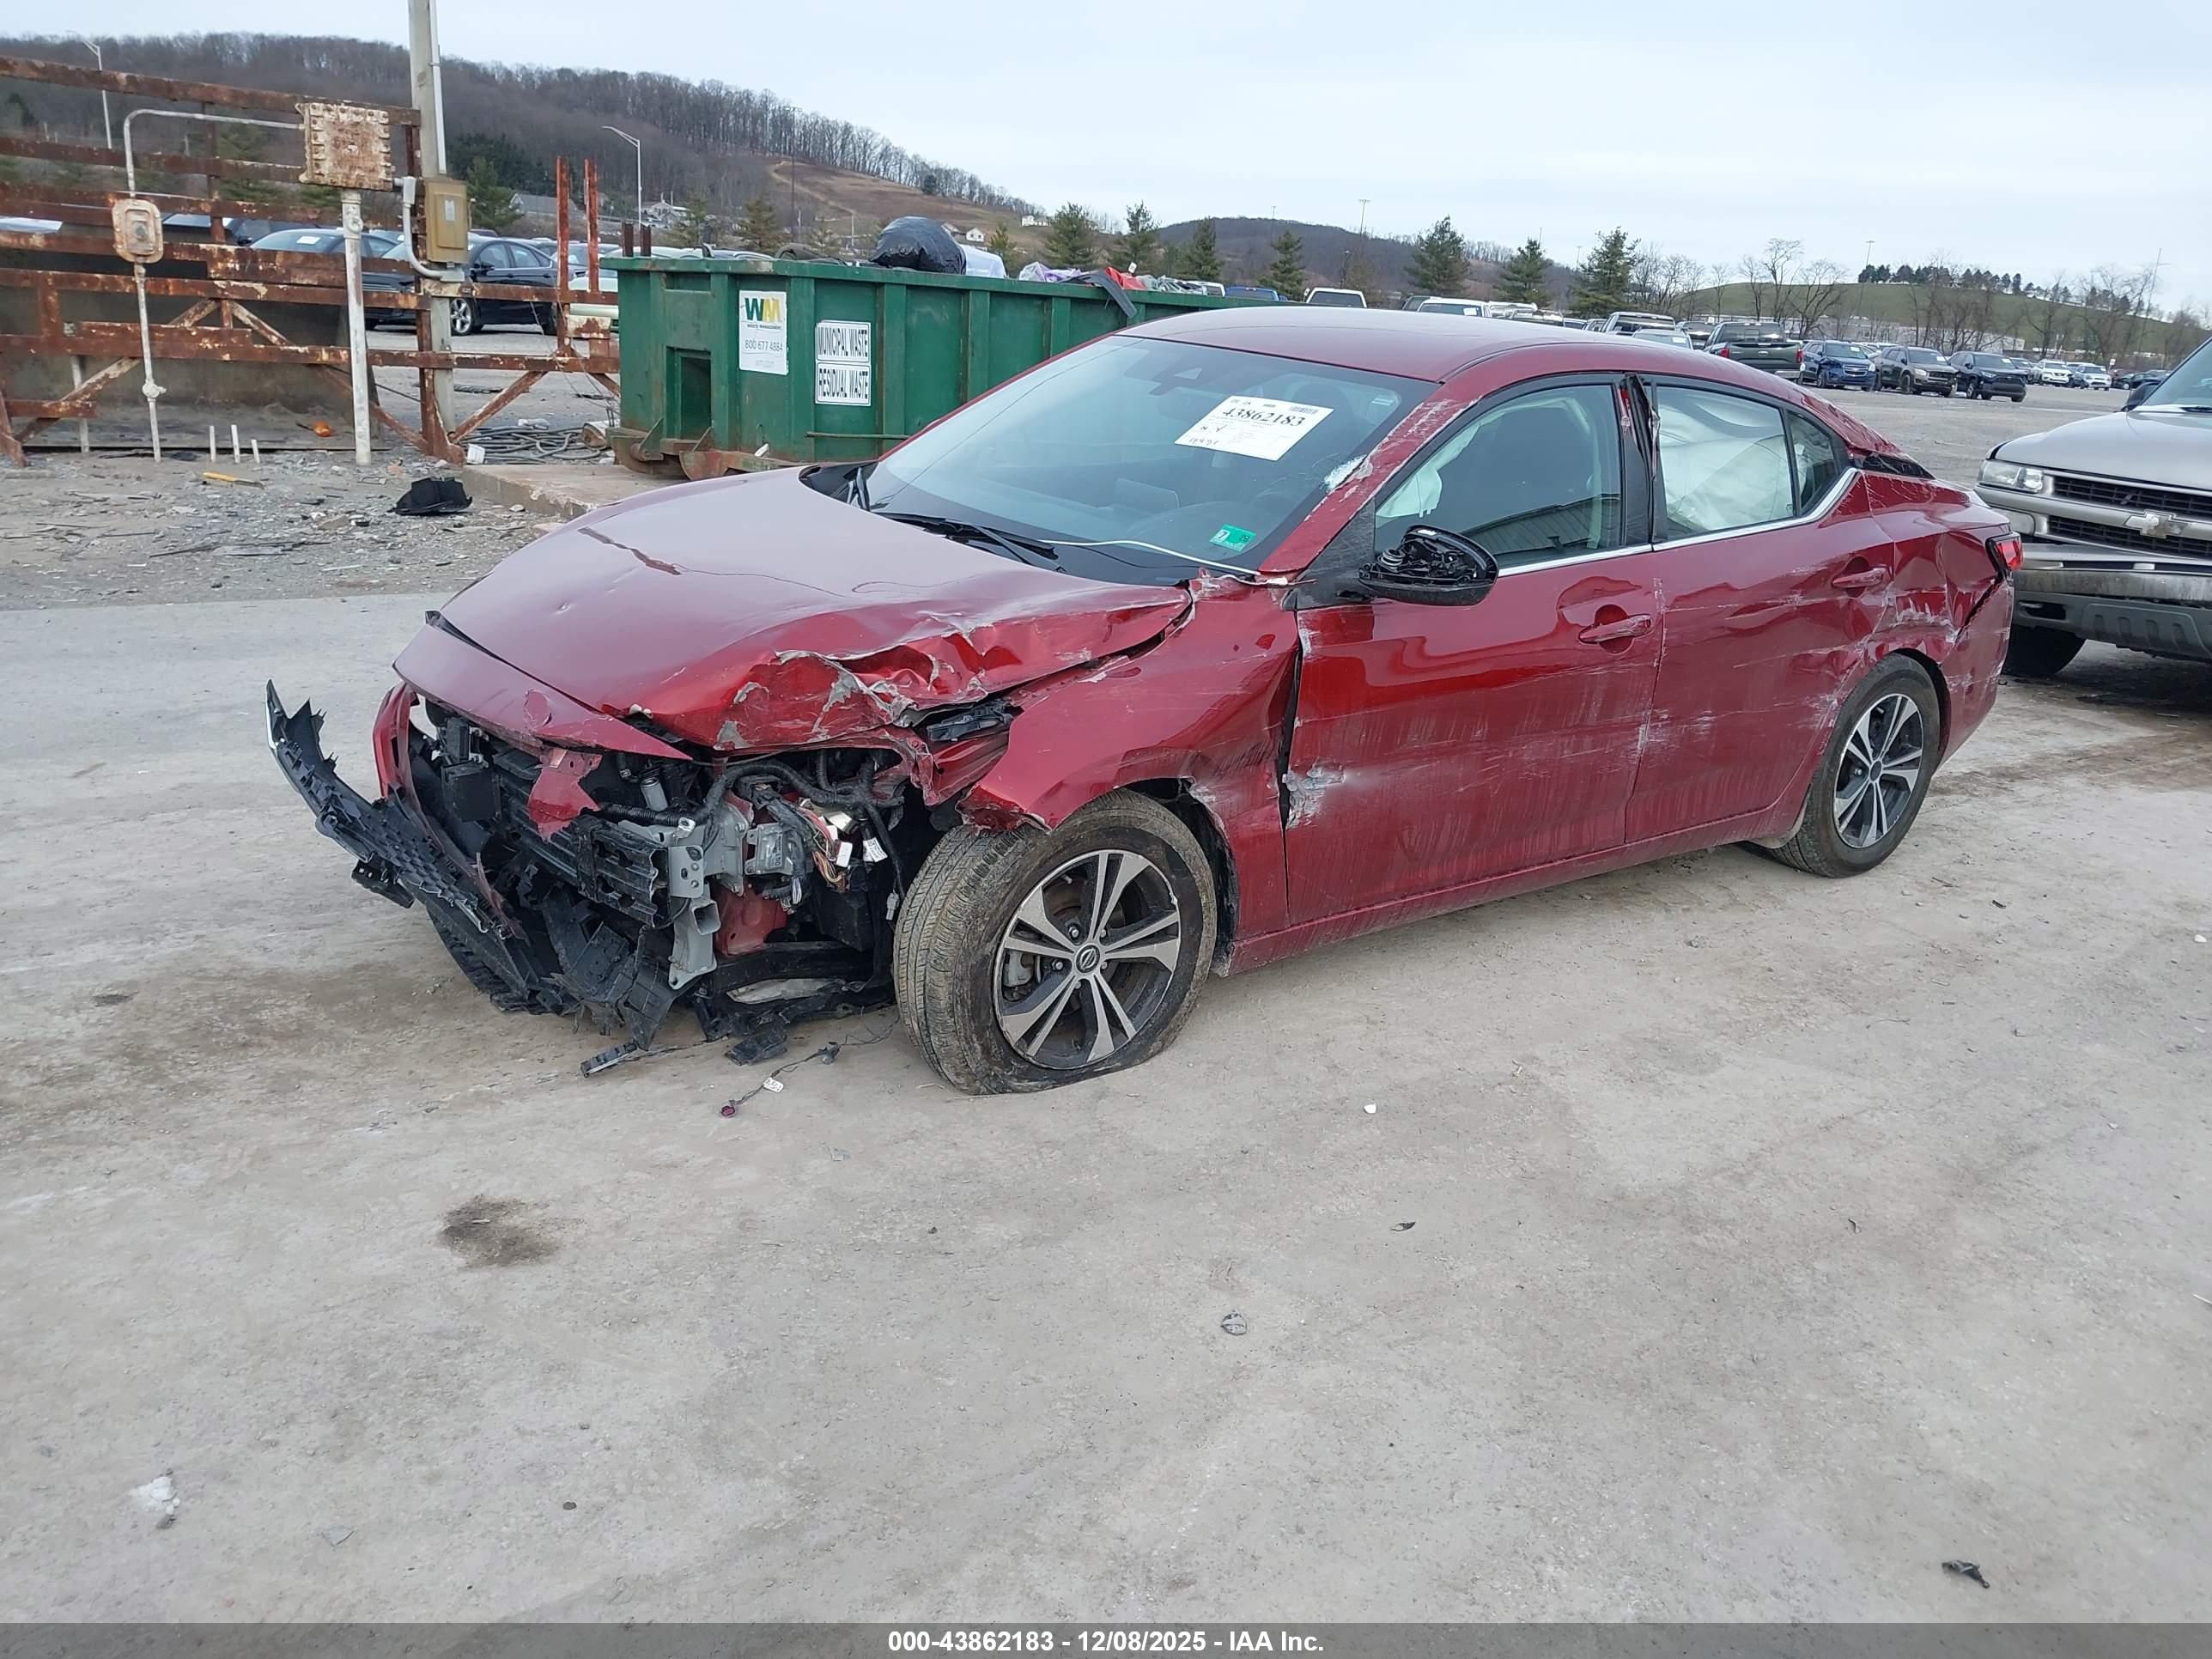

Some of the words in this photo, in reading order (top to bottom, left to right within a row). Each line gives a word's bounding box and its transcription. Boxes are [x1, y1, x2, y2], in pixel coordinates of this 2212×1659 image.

[744, 297, 781, 322] WM
[744, 339, 757, 349] 800
[757, 340, 769, 350] 677
[818, 327, 848, 356] MUNICIPAL
[849, 329, 867, 357] WASTE
[819, 368, 847, 398] RESIDUAL
[849, 370, 868, 399] WASTE
[1223, 407, 1305, 427] 43862183
